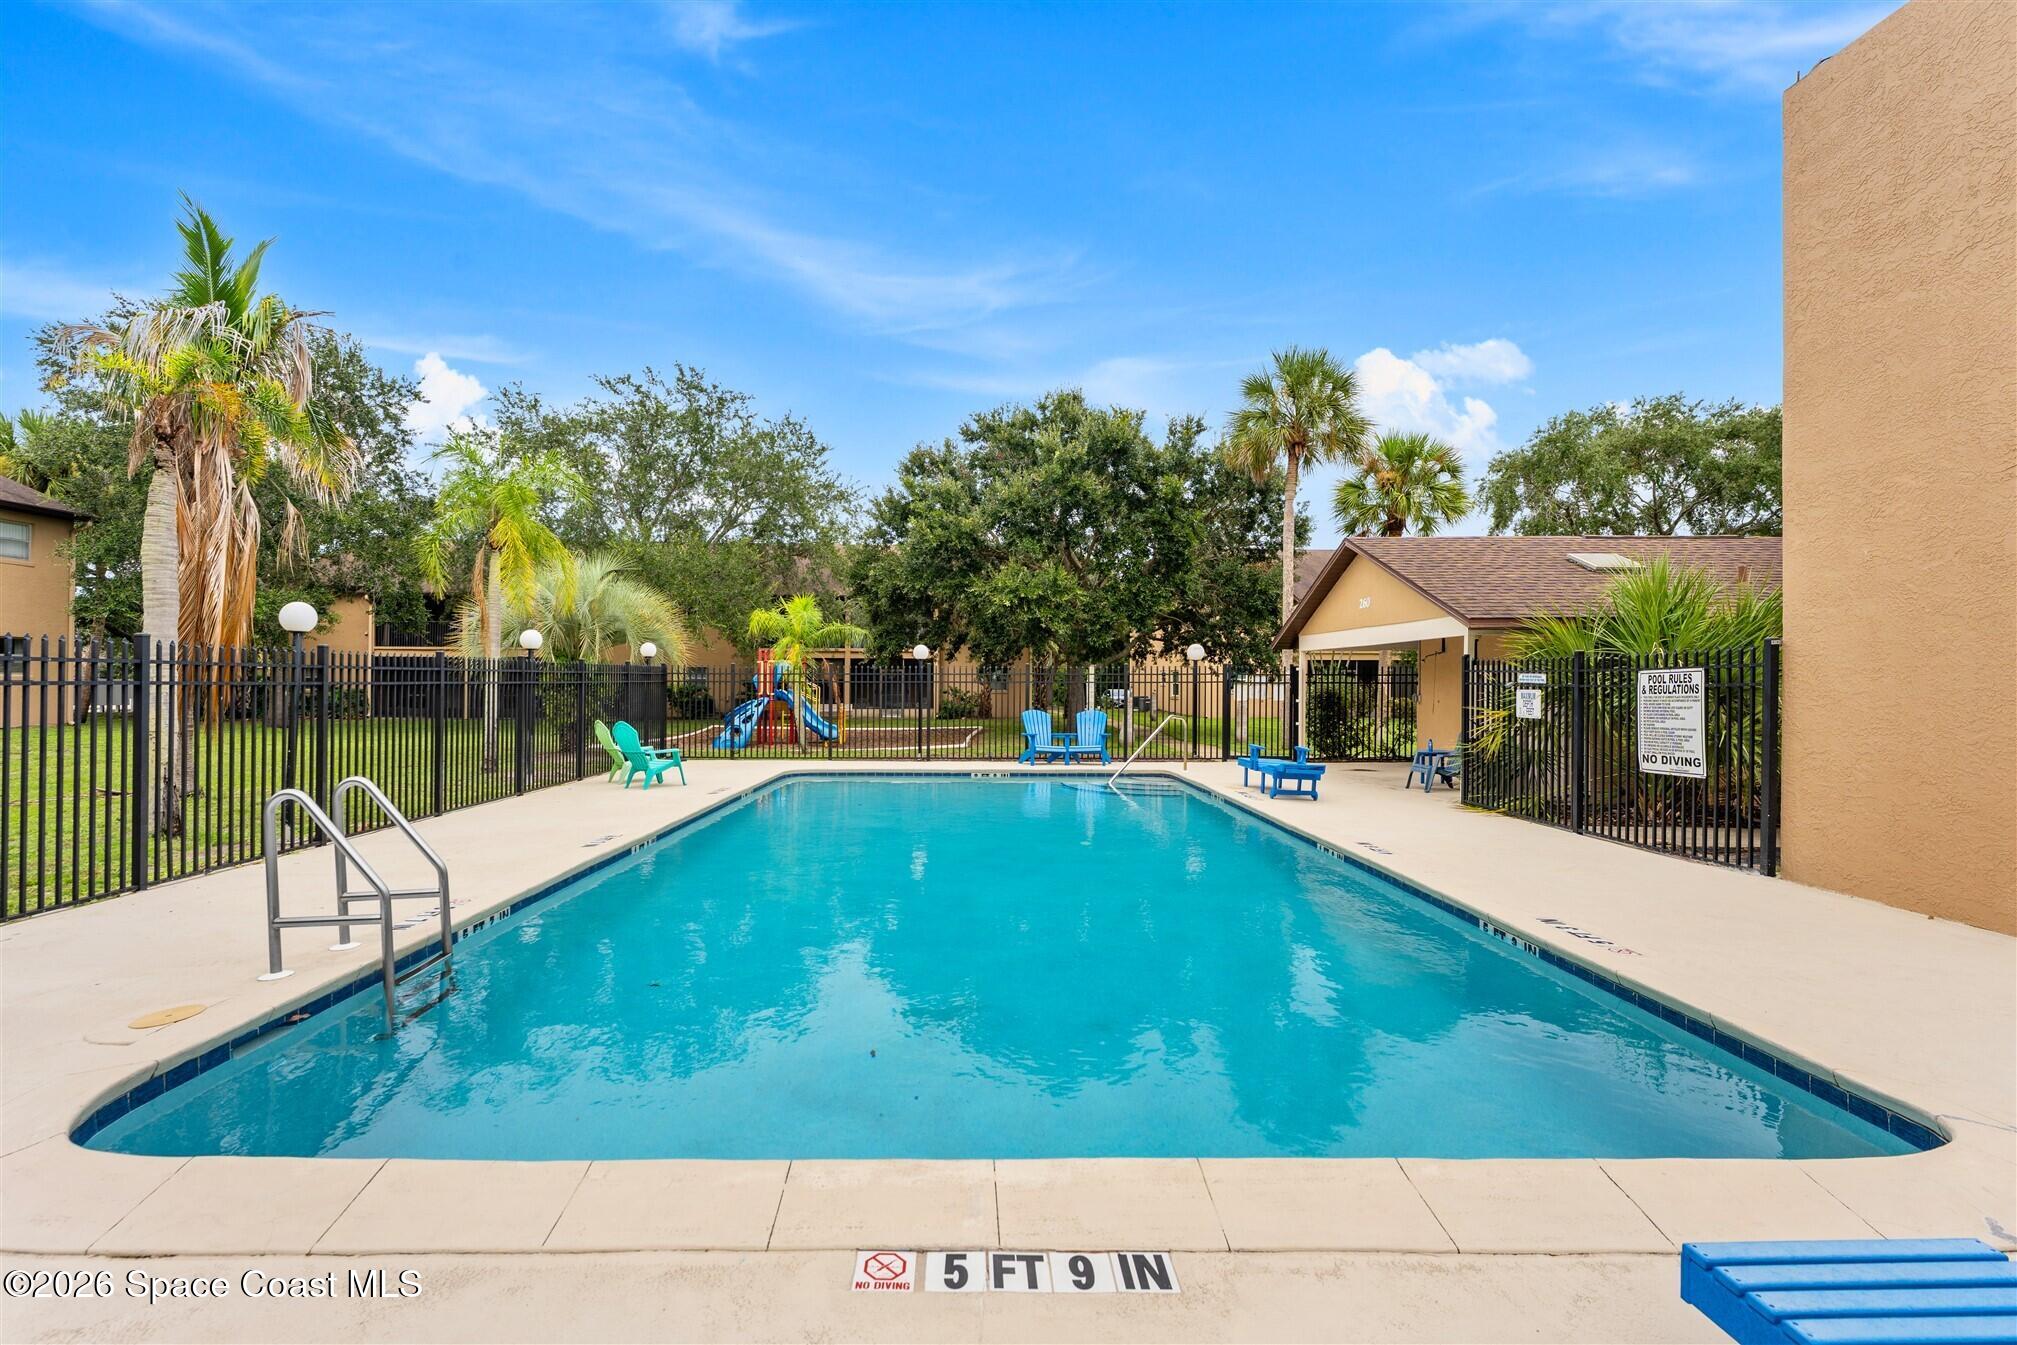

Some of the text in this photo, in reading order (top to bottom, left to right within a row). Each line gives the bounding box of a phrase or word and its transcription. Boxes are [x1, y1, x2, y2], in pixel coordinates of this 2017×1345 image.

[1648, 673, 1693, 684] POOL RULES
[1641, 684, 1700, 694] & REGULATIONS
[1642, 754, 1701, 767] NO DIVING
[473, 920, 485, 933] FT
[499, 908, 509, 920] IN
[1493, 927, 1506, 940] FT
[1524, 942, 1537, 956] IN
[943, 1254, 1173, 1291] 5 FT 9 IN
[855, 1281, 910, 1291] NO DIVING
